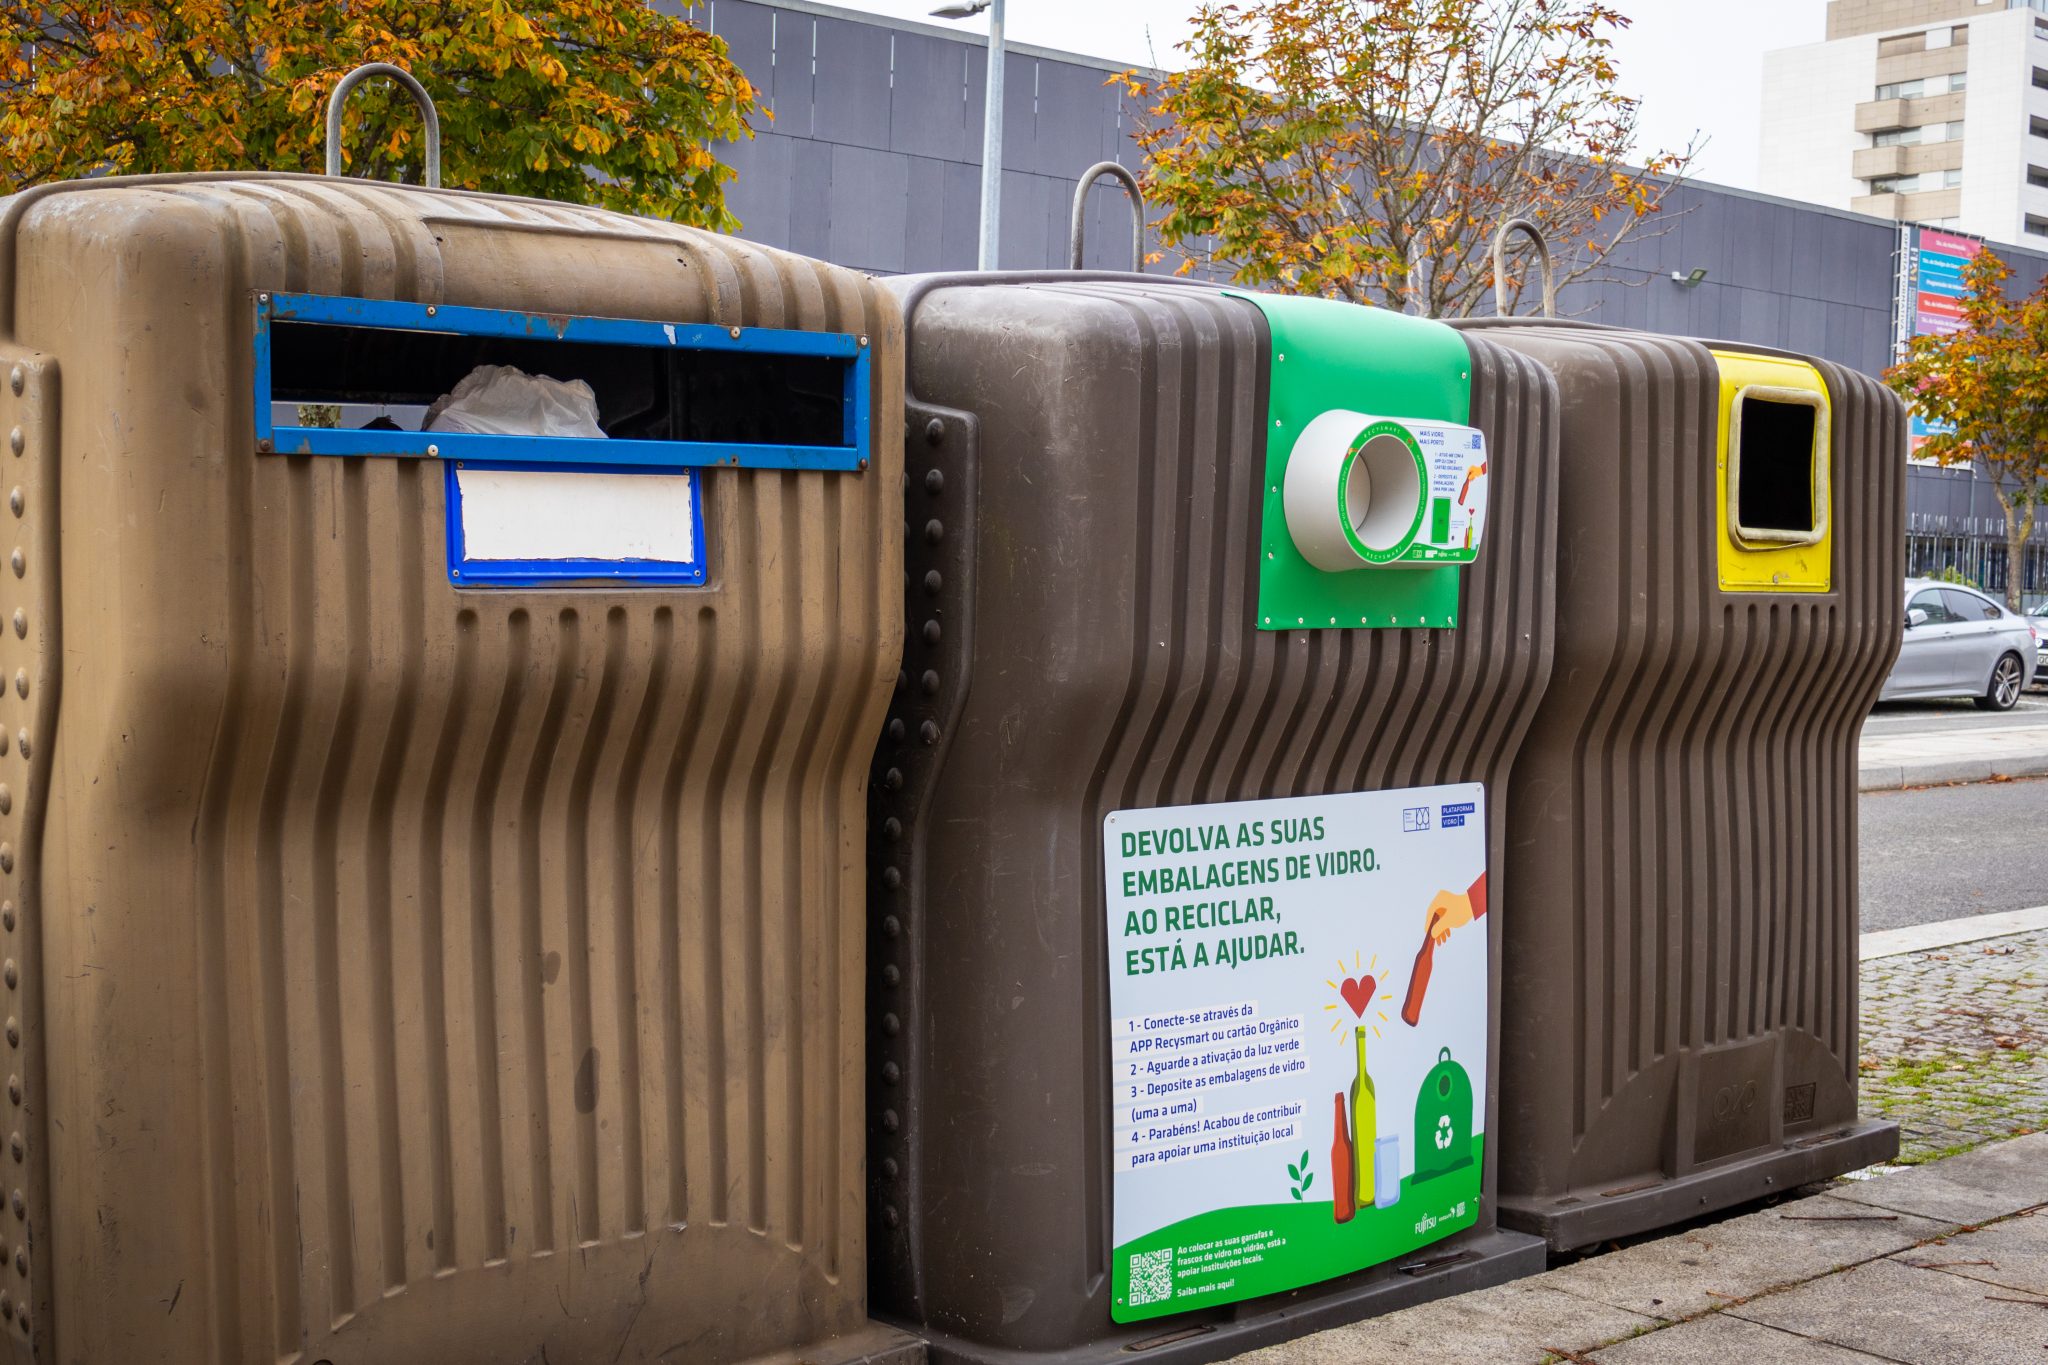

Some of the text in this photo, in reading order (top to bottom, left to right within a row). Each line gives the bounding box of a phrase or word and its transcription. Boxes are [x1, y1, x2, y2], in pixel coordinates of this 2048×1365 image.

[1443, 804, 1473, 814] PLATAFORMA
[1443, 818, 1457, 826] VIDRO
[1122, 816, 1324, 858] DEVOLVA AS SUAS
[1123, 848, 1380, 897] EMBALAGENS DE VIDRO.
[1124, 897, 1280, 936] AO RECICLAR,
[1126, 931, 1304, 976] ESTÁ A AJUDAR.
[1129, 1021, 1133, 1032] 1
[1144, 1014, 1200, 1030] Conecte-se
[1203, 1006, 1239, 1022] através
[1242, 1004, 1252, 1016] da
[1130, 1018, 1298, 1053] APP Recysmart ou cartão Orgânico
[1131, 1064, 1136, 1075] 2
[1147, 1056, 1190, 1075] Aguarde
[1193, 1057, 1198, 1066] a
[1201, 1049, 1242, 1064] ativação
[1245, 1046, 1255, 1058] da
[1258, 1043, 1272, 1055] luz
[1274, 1038, 1299, 1052] verde
[1131, 1086, 1137, 1098] 3
[1148, 1078, 1192, 1096] Deposite
[1195, 1078, 1206, 1087] as
[1209, 1068, 1266, 1085] embalagens
[1269, 1063, 1280, 1075] de
[1282, 1059, 1305, 1072] vidro
[1132, 1098, 1196, 1123] (uma a uma)
[1132, 1132, 1138, 1142] 4
[1149, 1121, 1200, 1140] Parabéns!
[1203, 1116, 1240, 1131] Acabou
[1243, 1112, 1254, 1124] de
[1257, 1103, 1301, 1121] contribuir
[1132, 1124, 1293, 1168] para apoiar uma instituição local
[1415, 1215, 1437, 1235] FUJITSU
[1177, 1245, 1187, 1255] Ao
[1188, 1239, 1214, 1254] colocar
[1215, 1239, 1223, 1247] as
[1224, 1235, 1240, 1245] suas
[1241, 1229, 1267, 1245] garrafas
[1177, 1253, 1203, 1266] frascos
[1204, 1252, 1213, 1261] de
[1214, 1248, 1232, 1260] vidro
[1233, 1247, 1242, 1256] no
[1243, 1241, 1266, 1255] vidrão,
[1267, 1238, 1280, 1247] está
[1177, 1253, 1264, 1279] apoiar instituições locais.
[1177, 1278, 1235, 1297] Saiba mais aqui!
